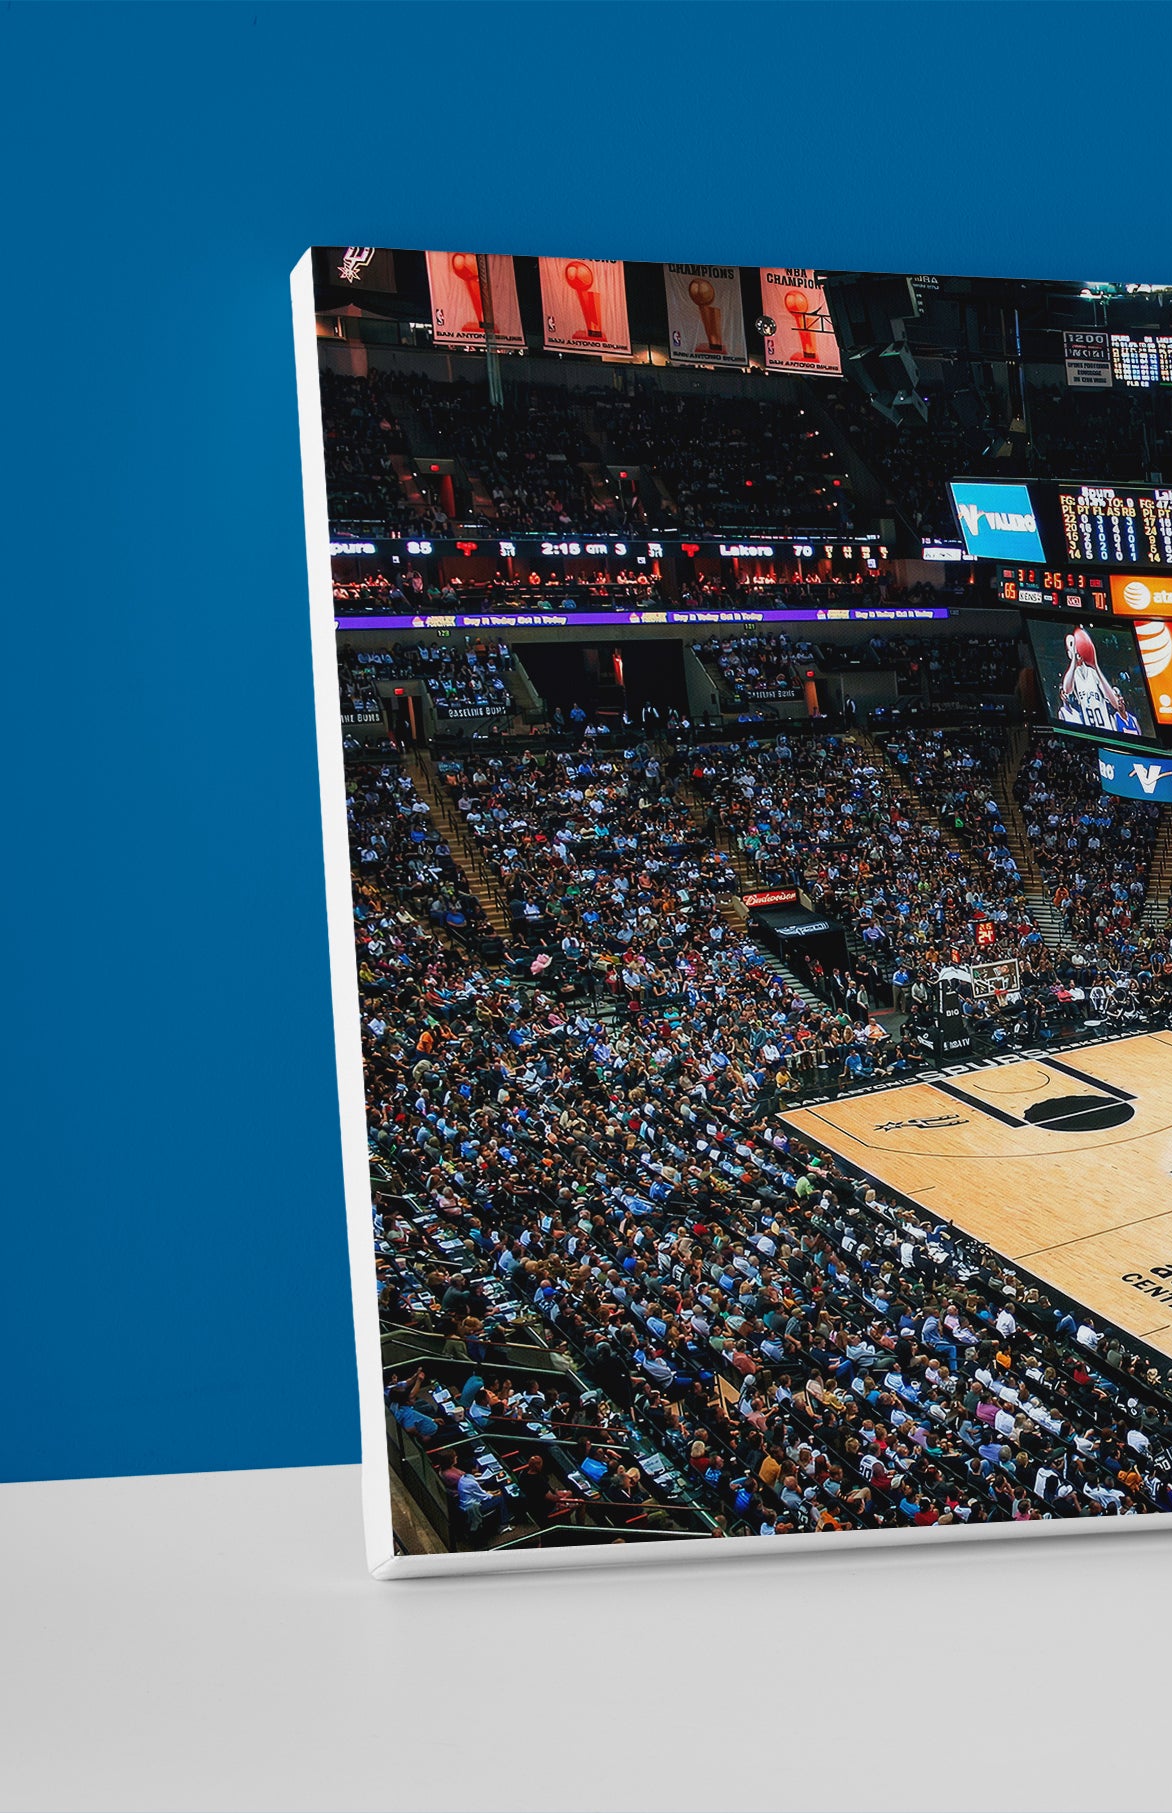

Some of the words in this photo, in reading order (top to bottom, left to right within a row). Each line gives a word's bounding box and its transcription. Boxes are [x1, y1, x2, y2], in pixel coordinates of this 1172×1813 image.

[1068, 334, 1104, 344] 1200
[1062, 505, 1075, 514] PL
[1077, 506, 1089, 515] PT
[1093, 507, 1104, 515] FL
[1107, 507, 1120, 516] AS
[1143, 509, 1156, 517] PL
[1158, 510, 1170, 518] PT
[1064, 514, 1076, 523] 22
[1081, 514, 1088, 523] 0
[1097, 515, 1103, 524] 3
[1126, 517, 1132, 525] 3
[1144, 518, 1155, 526] 17
[1145, 527, 1157, 535] 24
[1099, 534, 1105, 542] 0
[1128, 535, 1135, 543] 0
[407, 541, 432, 554] 85
[615, 543, 627, 555] 3
[719, 544, 773, 557] Lakers
[793, 544, 813, 557] 70
[1069, 541, 1076, 549] 3
[1100, 542, 1106, 551] 2
[1130, 544, 1135, 552] 1
[1069, 550, 1081, 558] 14
[1086, 551, 1093, 559] 5
[1101, 552, 1108, 560] 0
[1116, 552, 1123, 561] 0
[1131, 553, 1136, 561] 1
[1148, 553, 1160, 562] 14
[1166, 554, 1172, 563] 2
[1078, 575, 1086, 588] 3
[978, 931, 993, 943] 24
[787, 1096, 829, 1107] SAN
[837, 1077, 917, 1098] ANTONIO
[916, 1050, 1051, 1082] SPURS
[1046, 1029, 1148, 1052] BASKETBALL
